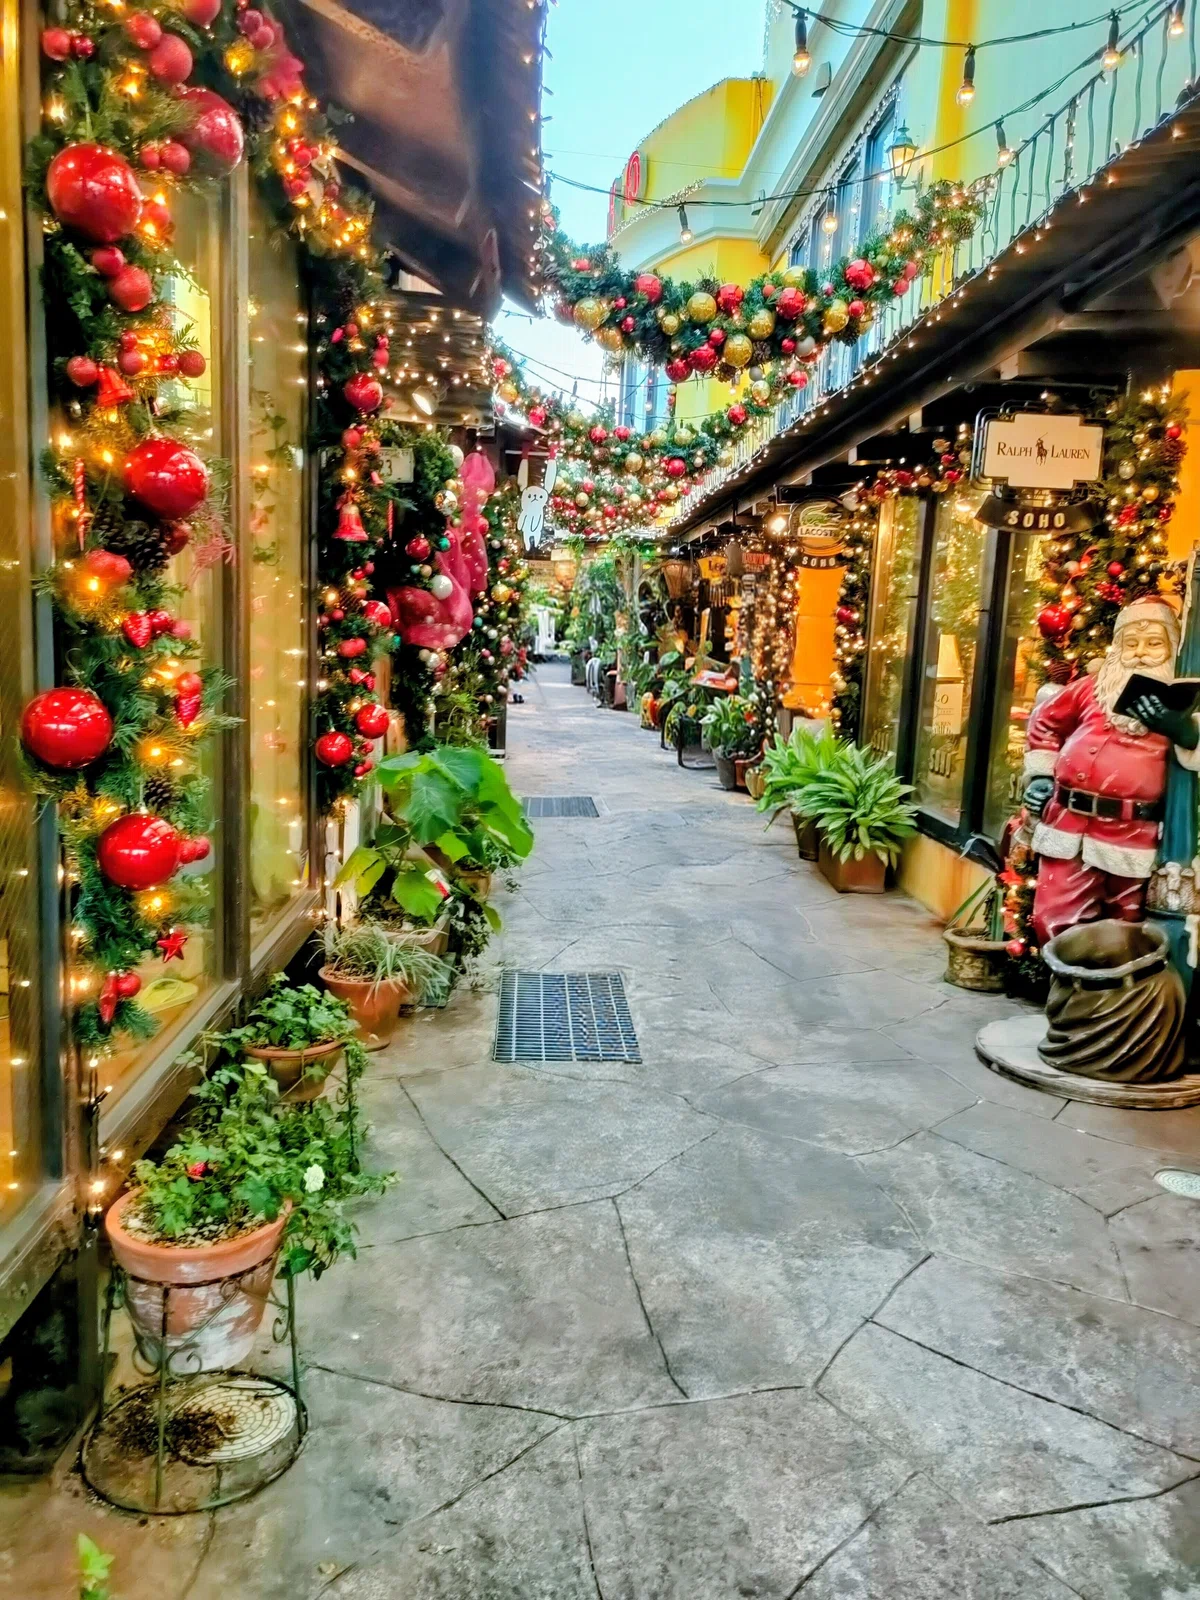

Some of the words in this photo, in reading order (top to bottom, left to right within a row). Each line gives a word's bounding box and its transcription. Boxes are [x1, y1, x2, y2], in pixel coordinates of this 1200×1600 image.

[996, 441, 1033, 457] RALPH
[1051, 444, 1090, 459] LAUREN
[1007, 510, 1066, 528] SOHO
[800, 528, 836, 537] LACOST
[801, 556, 836, 567] SOHO
